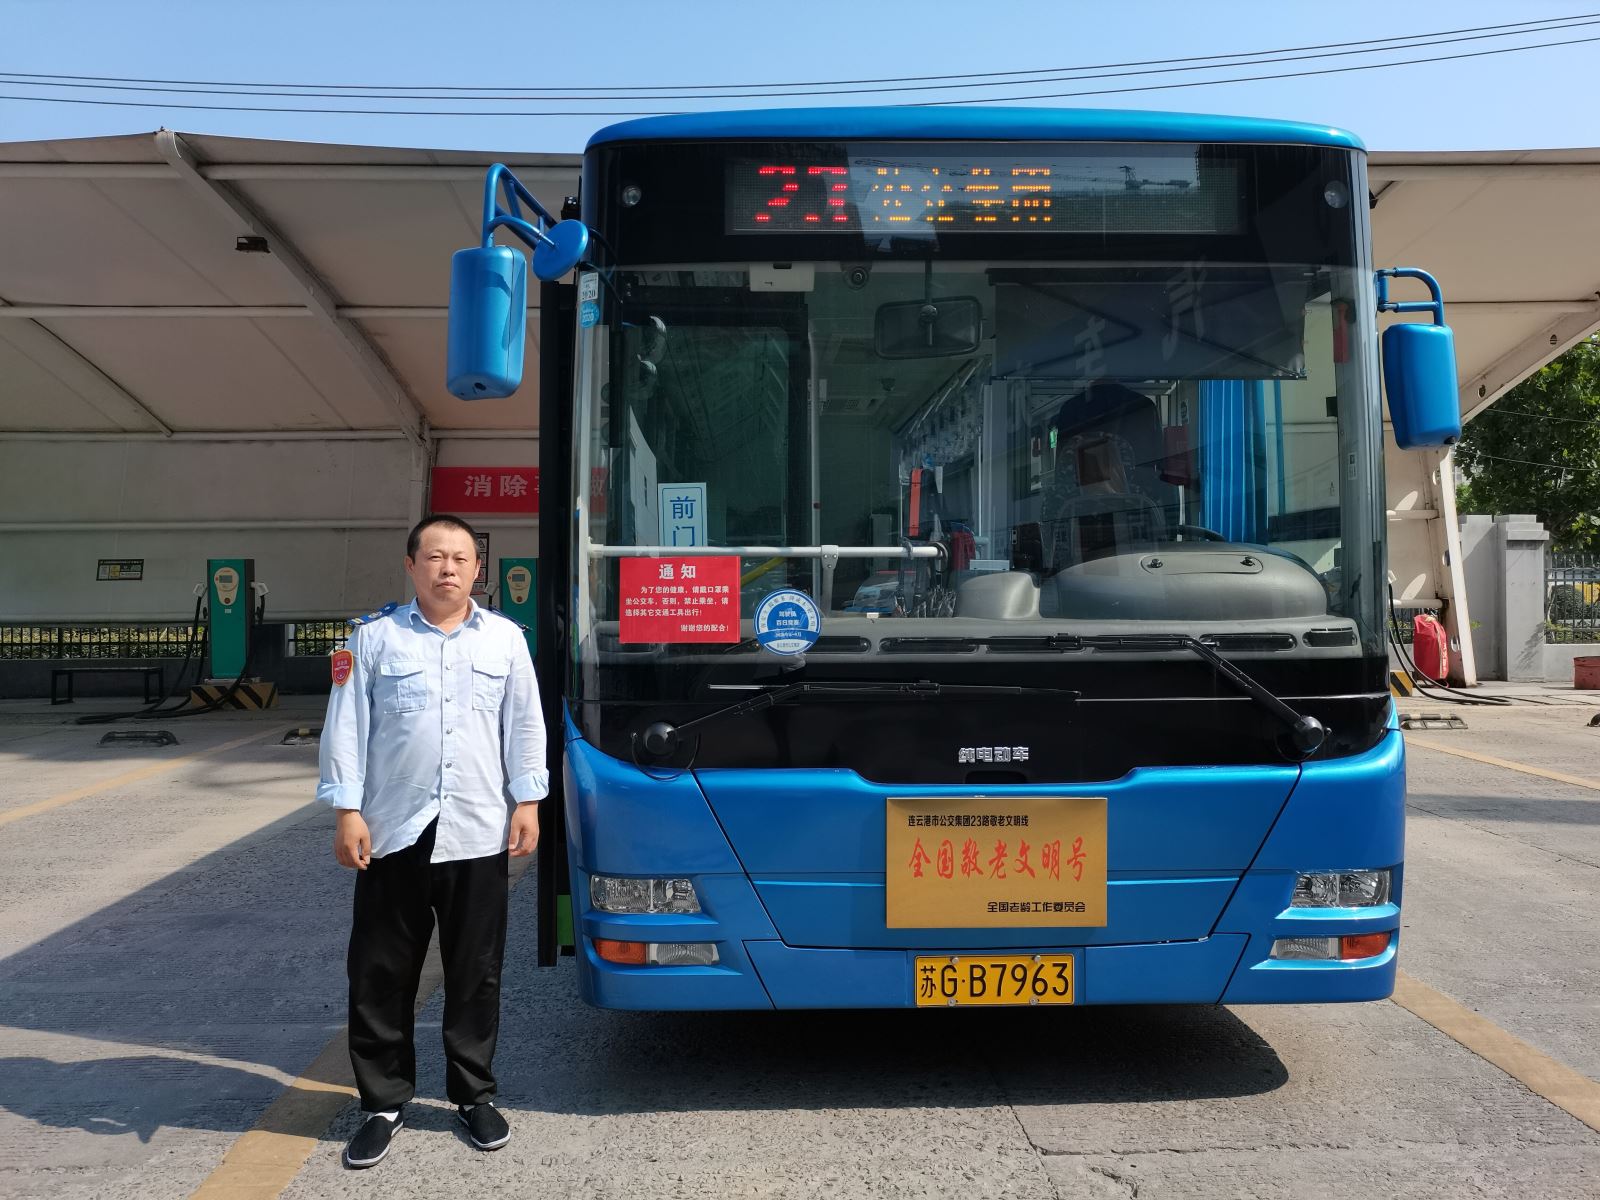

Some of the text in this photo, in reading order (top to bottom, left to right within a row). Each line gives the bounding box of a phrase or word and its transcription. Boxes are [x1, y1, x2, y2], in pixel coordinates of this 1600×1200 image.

[669, 496, 697, 546] 前门
[658, 563, 696, 580] 通知
[680, 623, 729, 632] 谢谢您的配合！
[958, 746, 1030, 763] 纯电动车
[908, 815, 1029, 827] 连云港市公交集团23路敬老文明线
[908, 836, 1087, 882] 全国敬老文明号
[987, 901, 1086, 913] 全国老龄工作委员会
[920, 962, 1070, 999] 苏G·B7963
